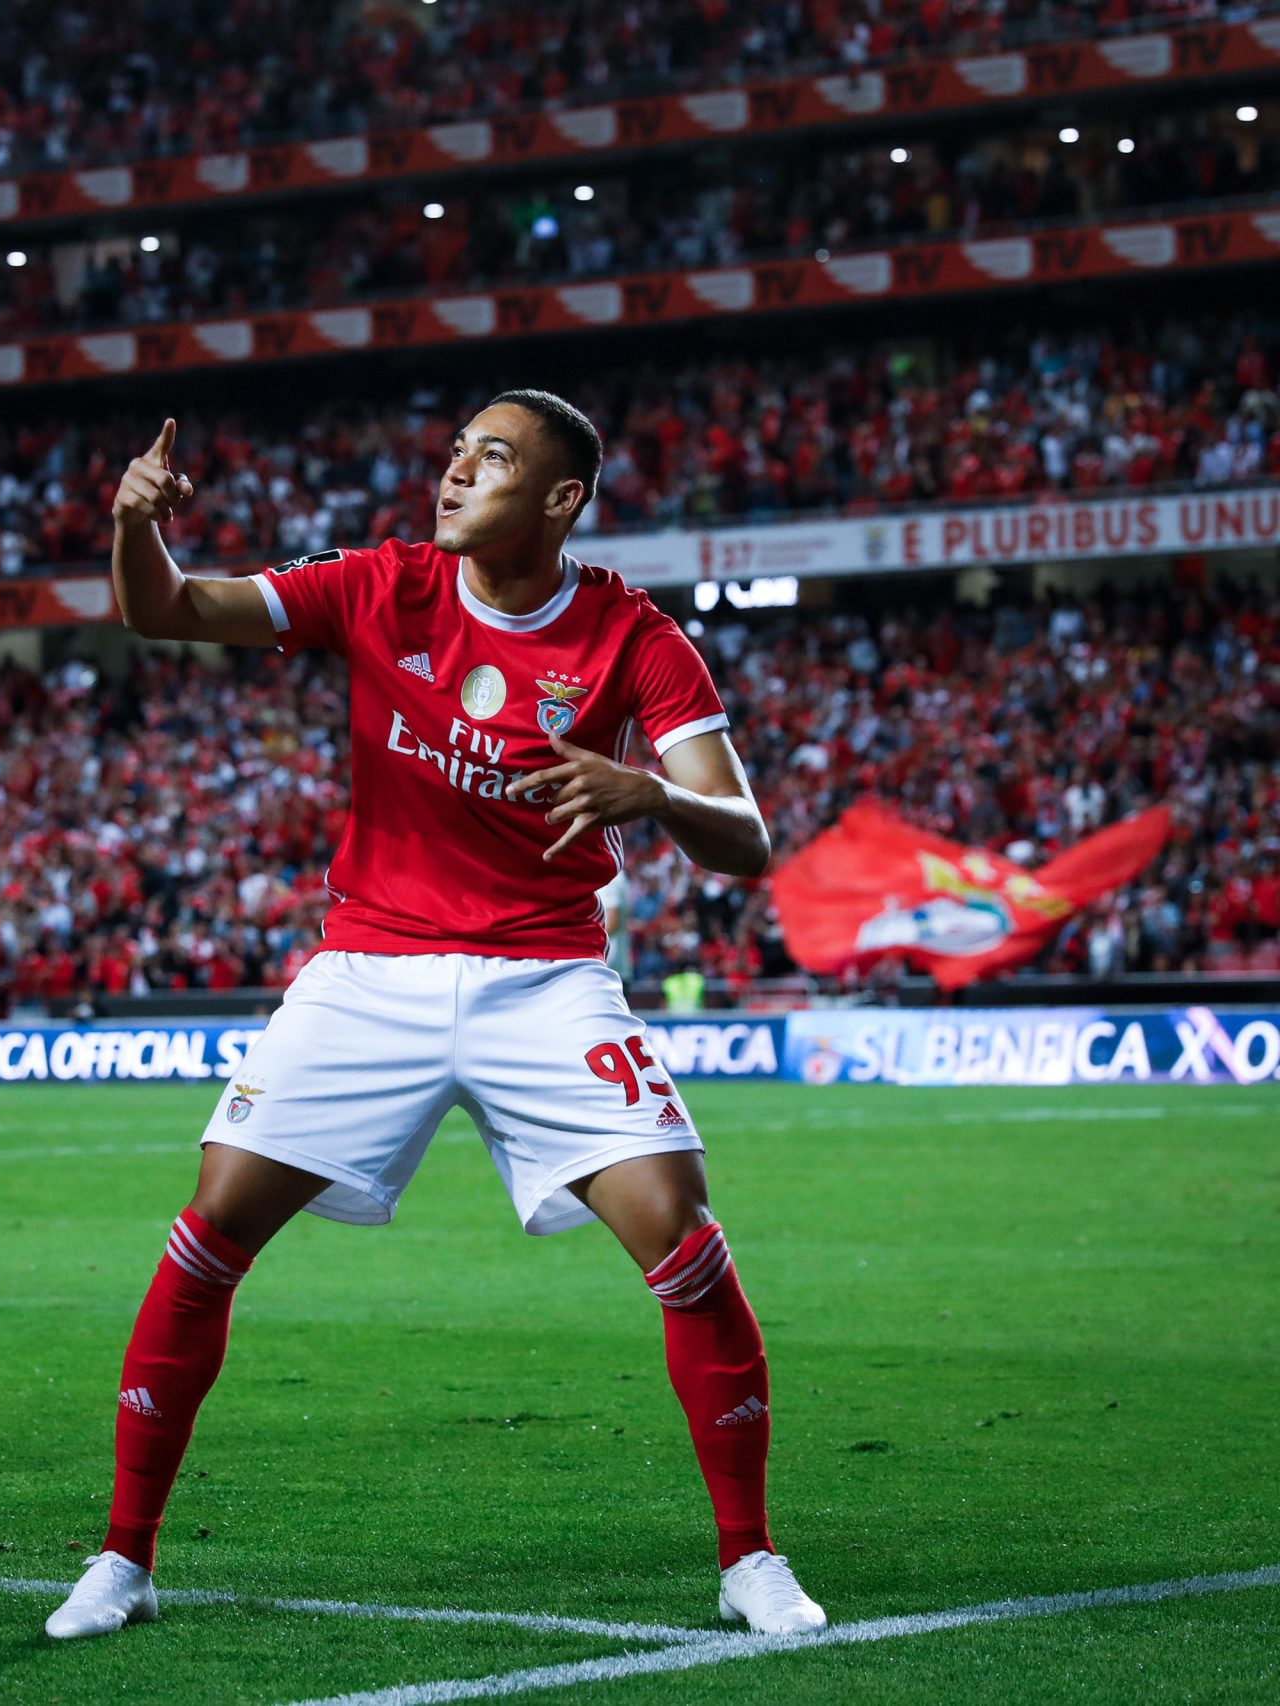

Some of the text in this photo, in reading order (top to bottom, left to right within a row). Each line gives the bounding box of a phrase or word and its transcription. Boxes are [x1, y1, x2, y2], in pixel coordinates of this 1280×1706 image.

[903, 520, 921, 562] E
[943, 502, 1158, 558] PLURIBUS
[397, 659, 436, 683] adidas
[448, 717, 506, 764] Fly
[50, 1031, 212, 1079] OFFICIAL
[584, 1035, 673, 1107] 95
[923, 1020, 1152, 1083] BENFICA
[118, 1394, 162, 1418] adidas
